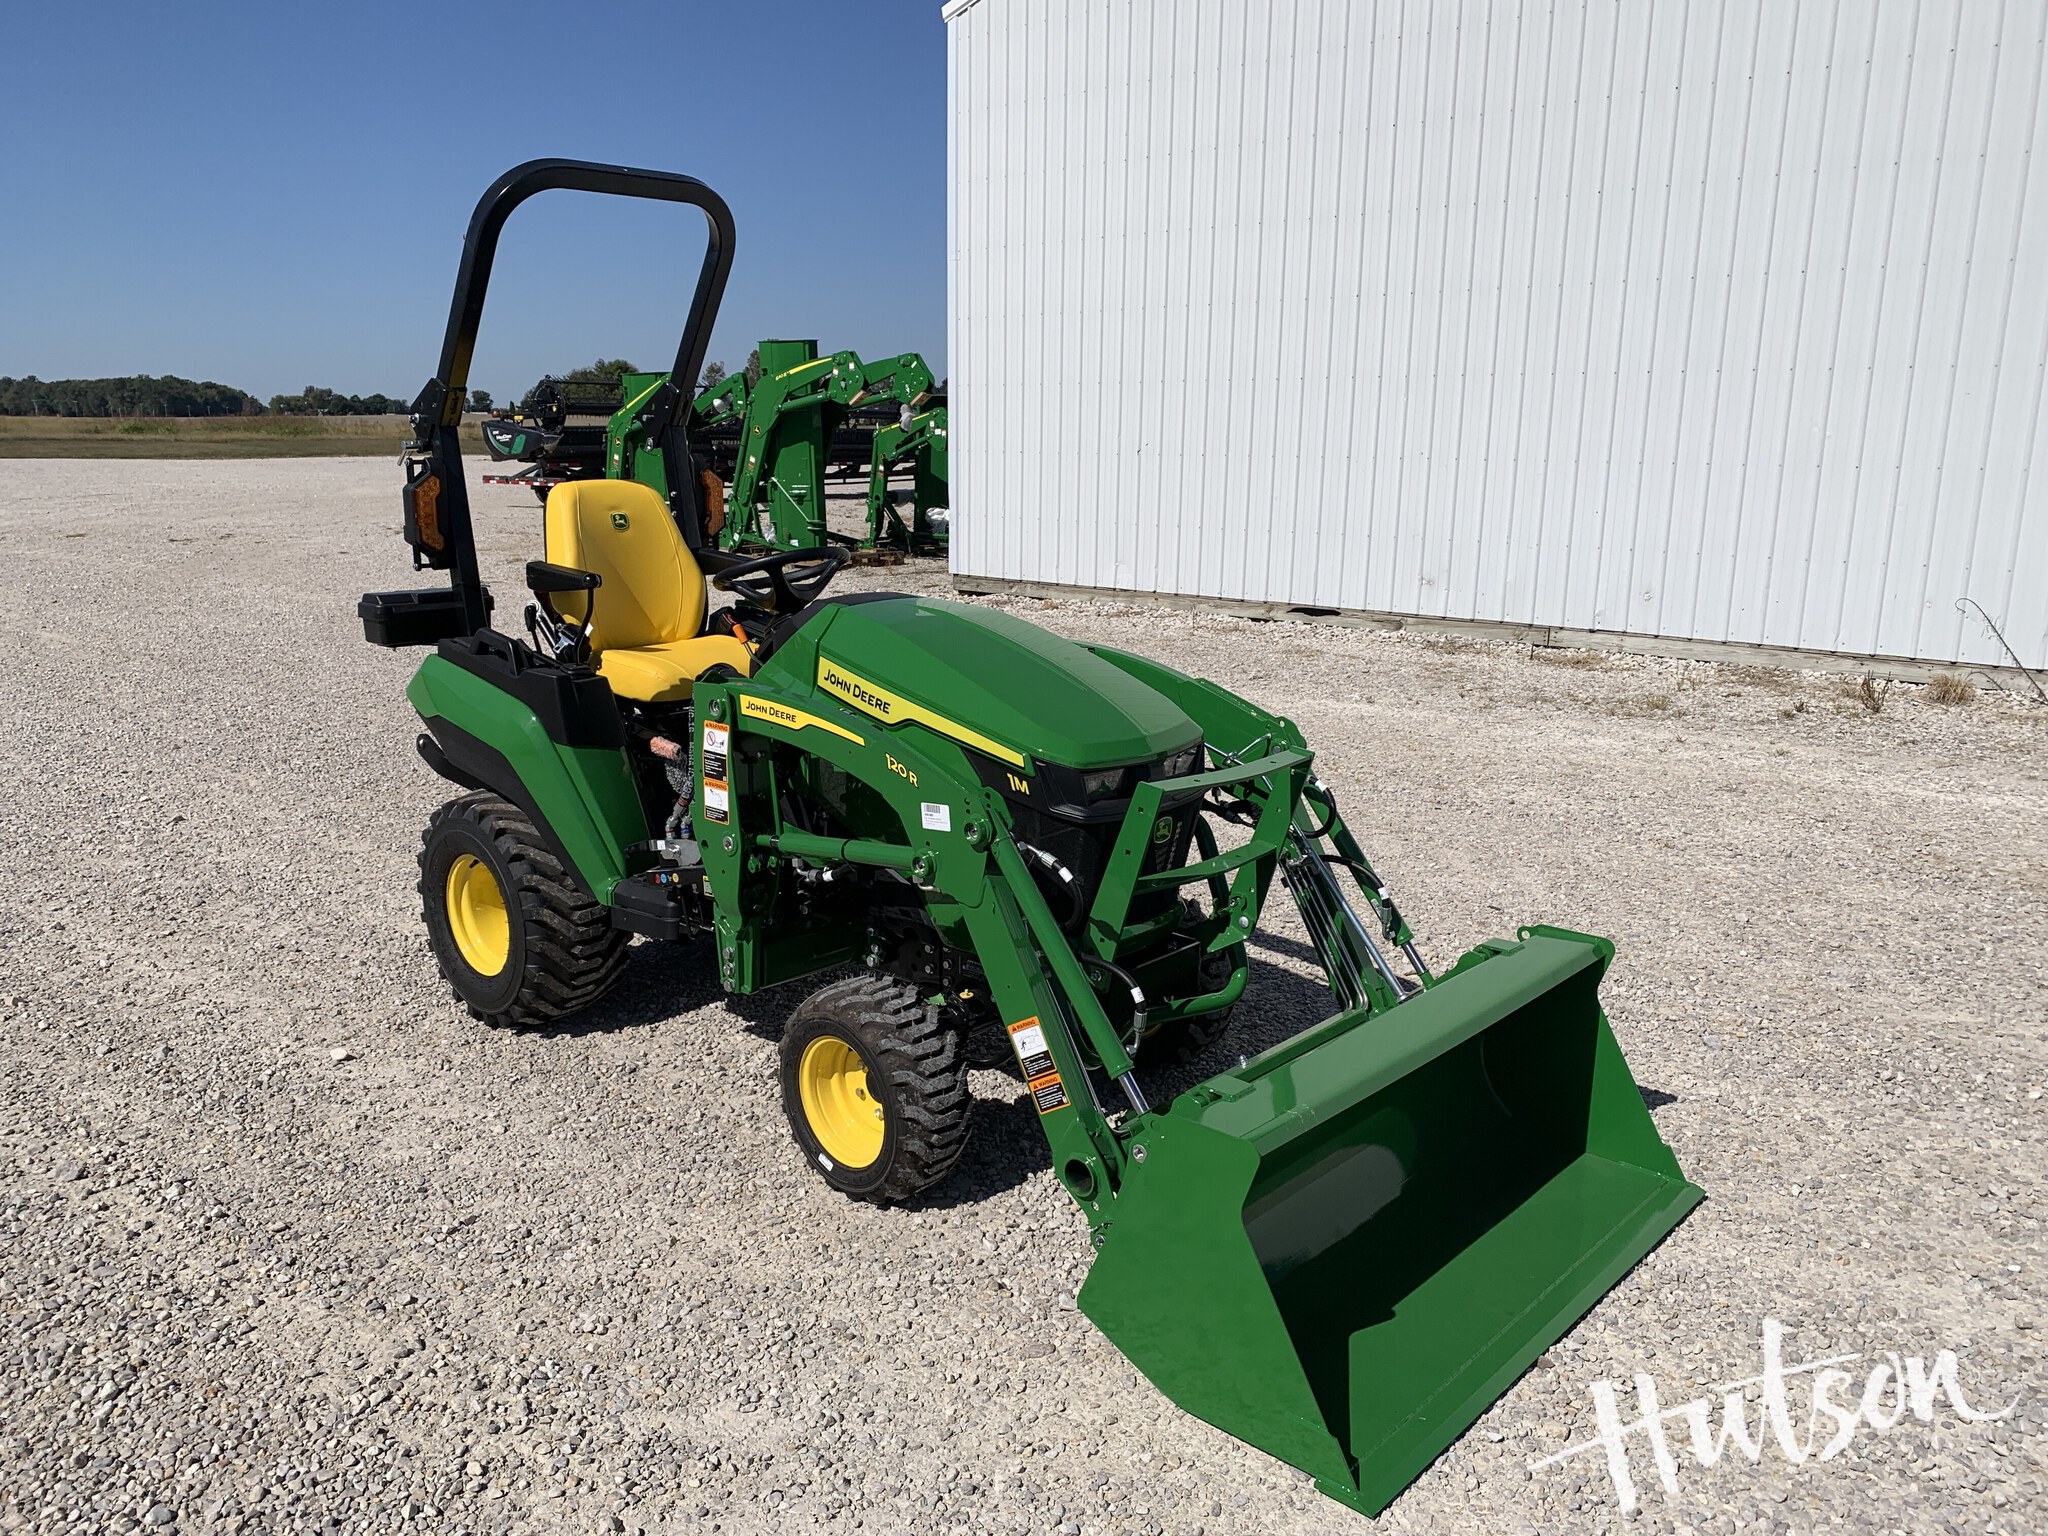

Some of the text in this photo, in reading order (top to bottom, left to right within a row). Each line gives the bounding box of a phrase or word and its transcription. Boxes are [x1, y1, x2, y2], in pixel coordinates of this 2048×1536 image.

[823, 668, 891, 715] JOHN DEERE
[745, 700, 797, 723] JOHN DEERE
[708, 722, 728, 732] WARNING
[708, 781, 728, 791] WARNING
[1006, 772, 1030, 795] 1M
[1016, 1020, 1036, 1030] WARNING
[1038, 1077, 1058, 1088] WARNING
